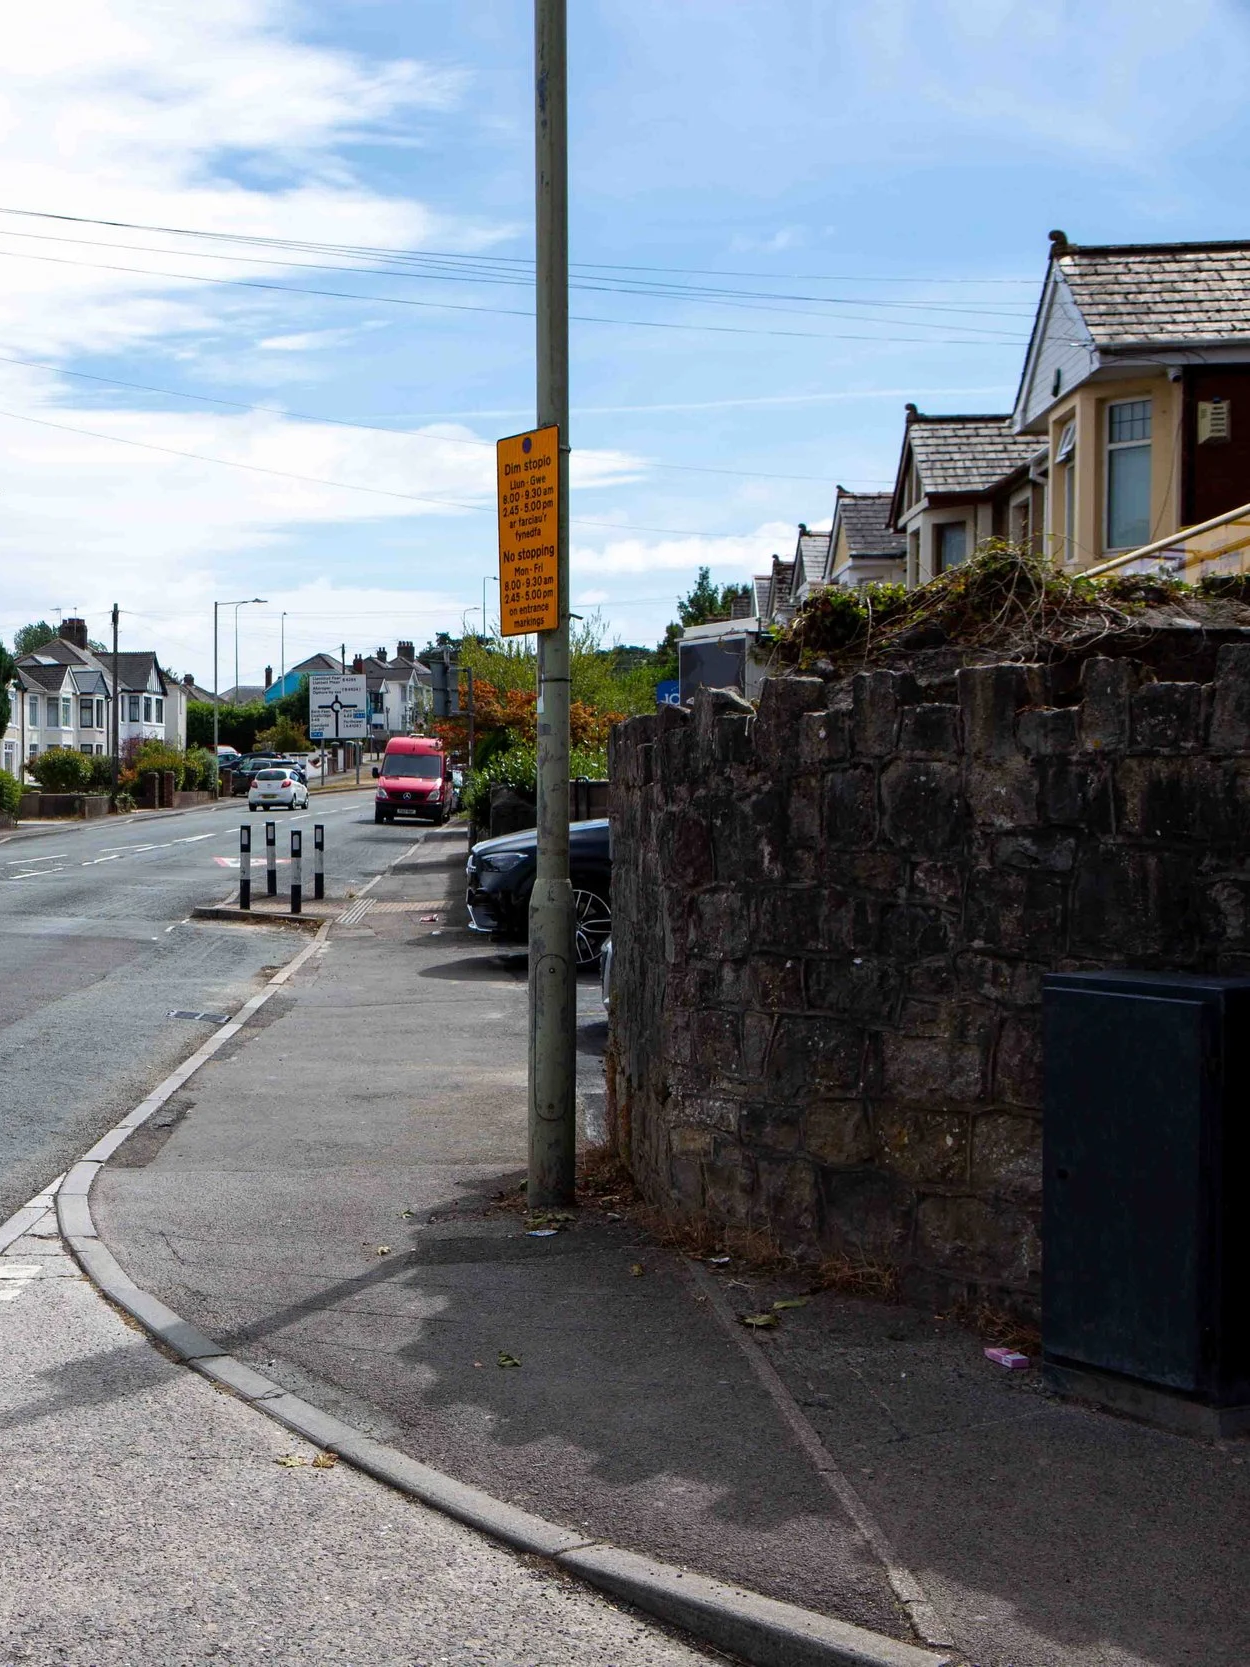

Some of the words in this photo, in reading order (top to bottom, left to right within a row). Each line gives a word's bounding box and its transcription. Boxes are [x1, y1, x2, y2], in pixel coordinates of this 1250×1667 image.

[505, 464, 521, 476] Dim
[524, 455, 551, 471] stopio
[510, 480, 524, 490] Llun
[530, 475, 546, 485] Gwe
[503, 492, 519, 504] 8.00
[525, 487, 541, 499] 9.30
[543, 486, 553, 495] am
[503, 505, 519, 517] 2.45
[524, 501, 541, 512] 5.00
[543, 500, 553, 510] pm
[516, 527, 541, 541] fynedfa
[504, 552, 515, 563] No
[518, 544, 554, 560] stopping
[515, 567, 529, 576] Mon
[534, 563, 543, 573] Fri
[505, 580, 520, 591] 8.00
[526, 576, 542, 588] 9.30
[544, 576, 553, 584] am
[505, 593, 520, 604] 2.45
[526, 589, 542, 600] 5.00
[543, 589, 553, 599] pm
[510, 608, 517, 616] on
[520, 603, 549, 615] entrance
[514, 616, 544, 628] markings
